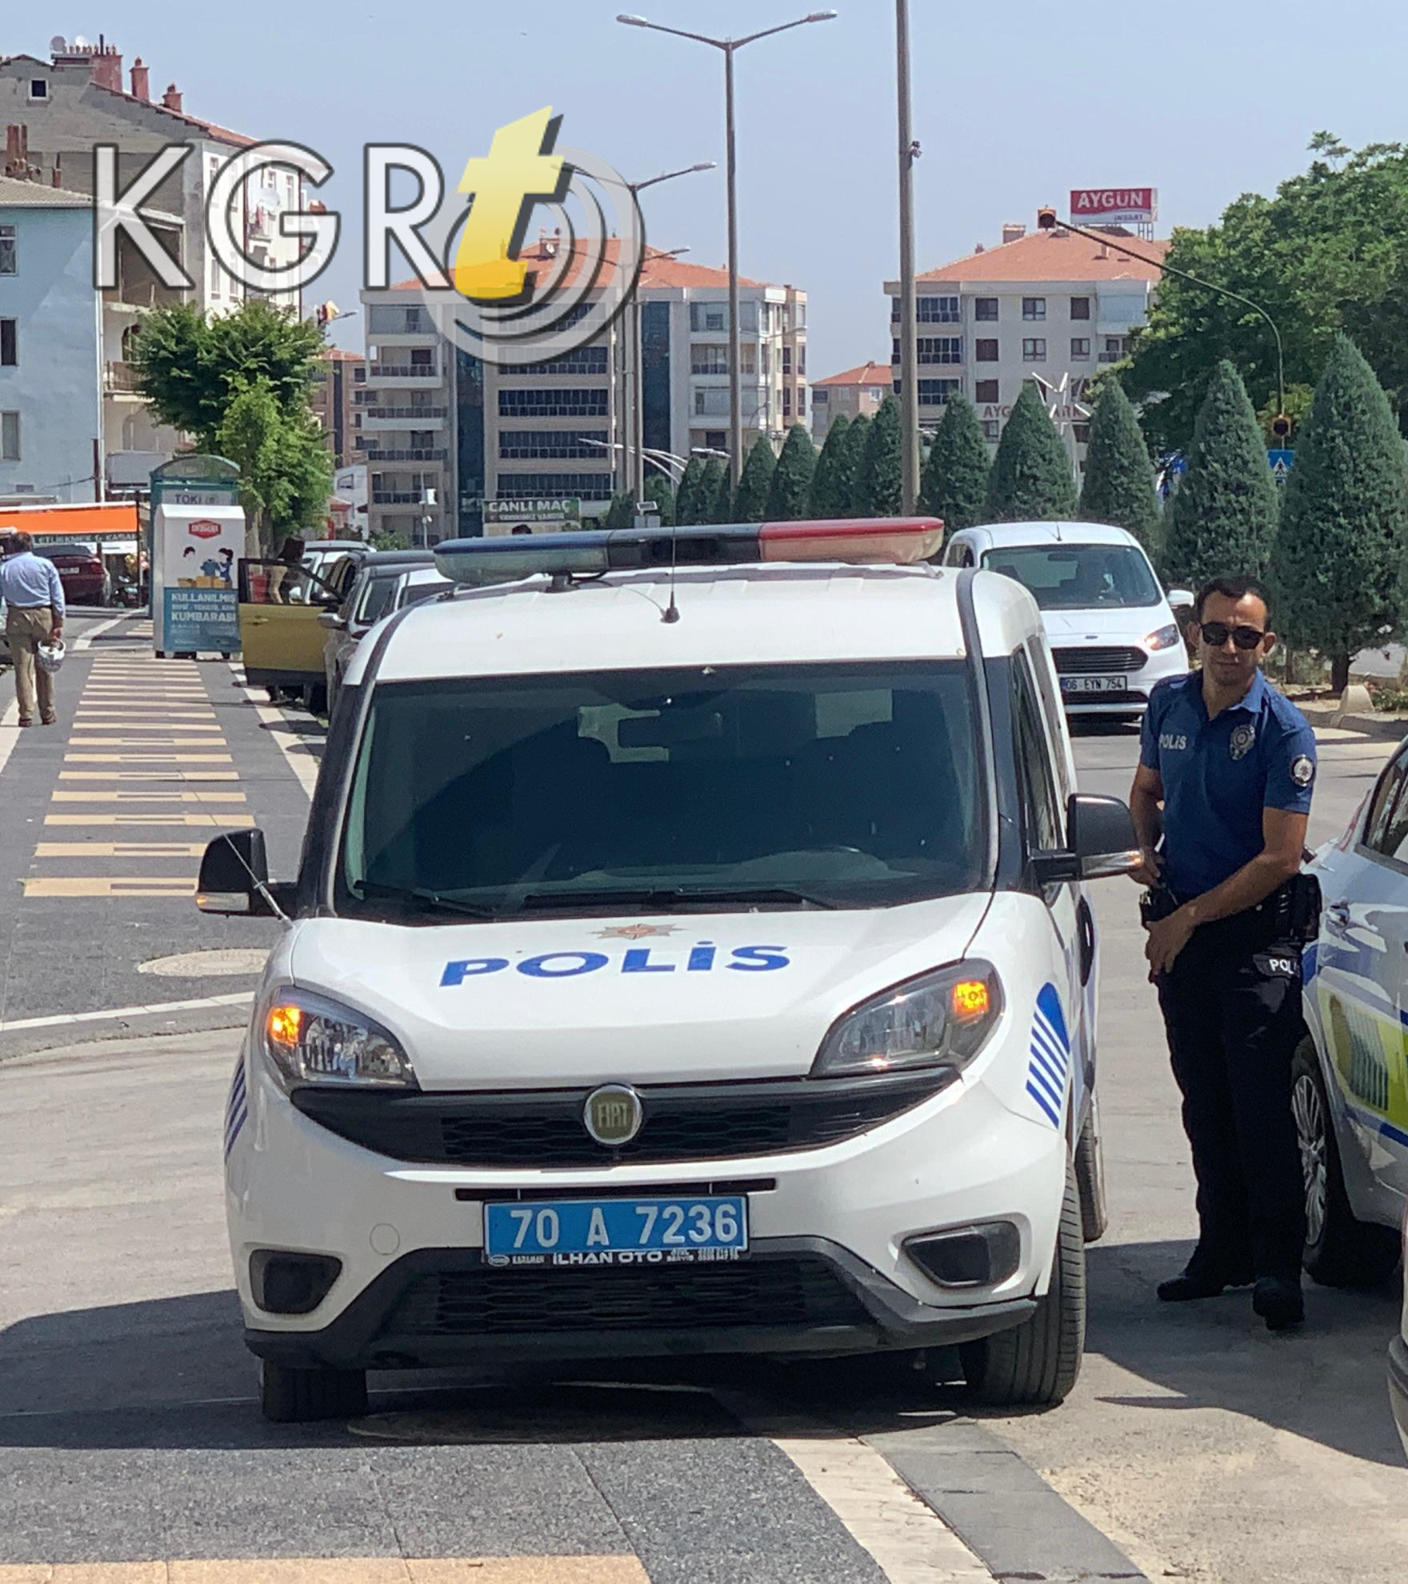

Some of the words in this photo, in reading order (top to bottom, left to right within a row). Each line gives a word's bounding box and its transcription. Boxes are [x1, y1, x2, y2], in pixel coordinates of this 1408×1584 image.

[489, 501, 534, 512] CANLI
[439, 940, 791, 987] POLİS
[598, 1103, 629, 1128] FIAT
[510, 1208, 559, 1248] 70
[586, 1207, 610, 1247] A
[635, 1203, 739, 1245] 7236
[552, 1251, 613, 1265] İLHAN
[619, 1250, 663, 1263] OTO
